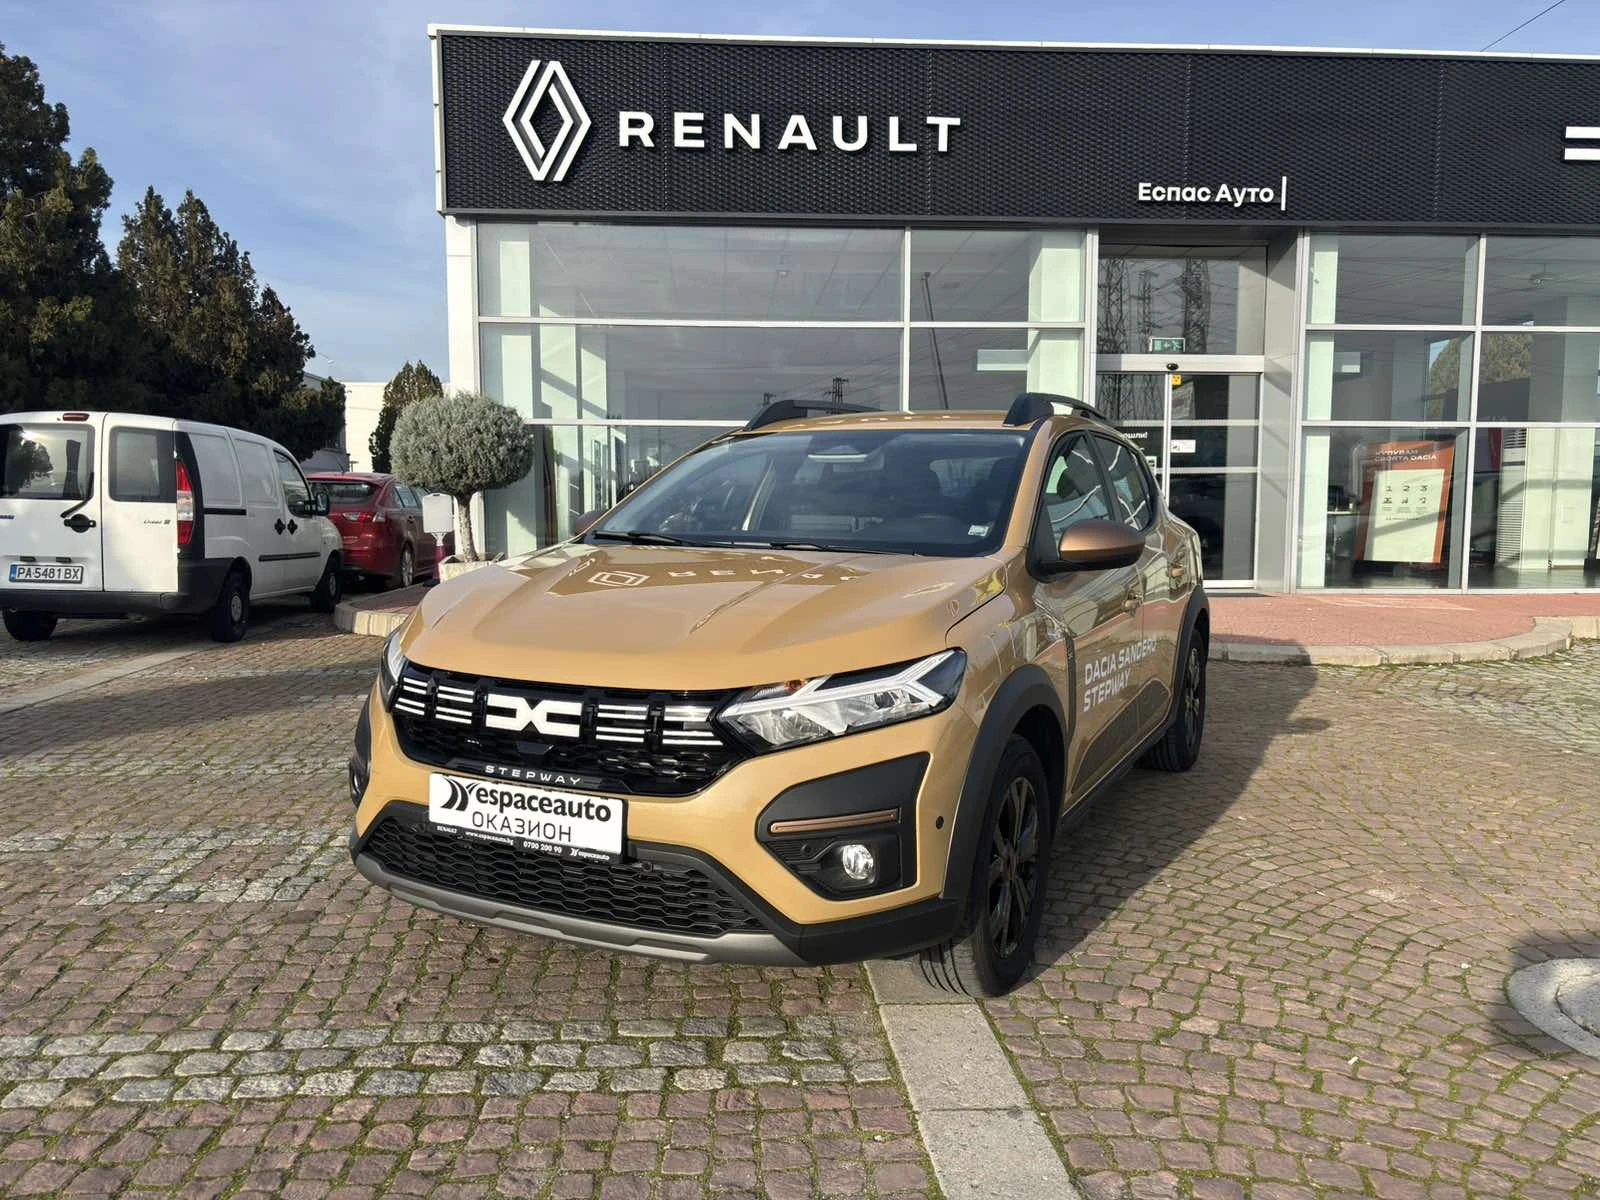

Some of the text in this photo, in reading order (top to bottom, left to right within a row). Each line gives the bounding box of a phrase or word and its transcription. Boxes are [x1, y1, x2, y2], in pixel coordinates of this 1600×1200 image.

[619, 111, 961, 152] RENAULT
[1138, 182, 1274, 207] Еспас Ауто
[17, 567, 32, 579] PA
[34, 568, 61, 579] 5481
[64, 569, 80, 579] BX
[1085, 652, 1117, 685] DACIA
[1083, 667, 1131, 712] STEPWAY
[485, 765, 581, 785] STEPWAY
[475, 786, 612, 822] espaceauto
[472, 811, 572, 843] ОКАЗИОН
[523, 841, 539, 850] 0700
[540, 843, 552, 852] 200
